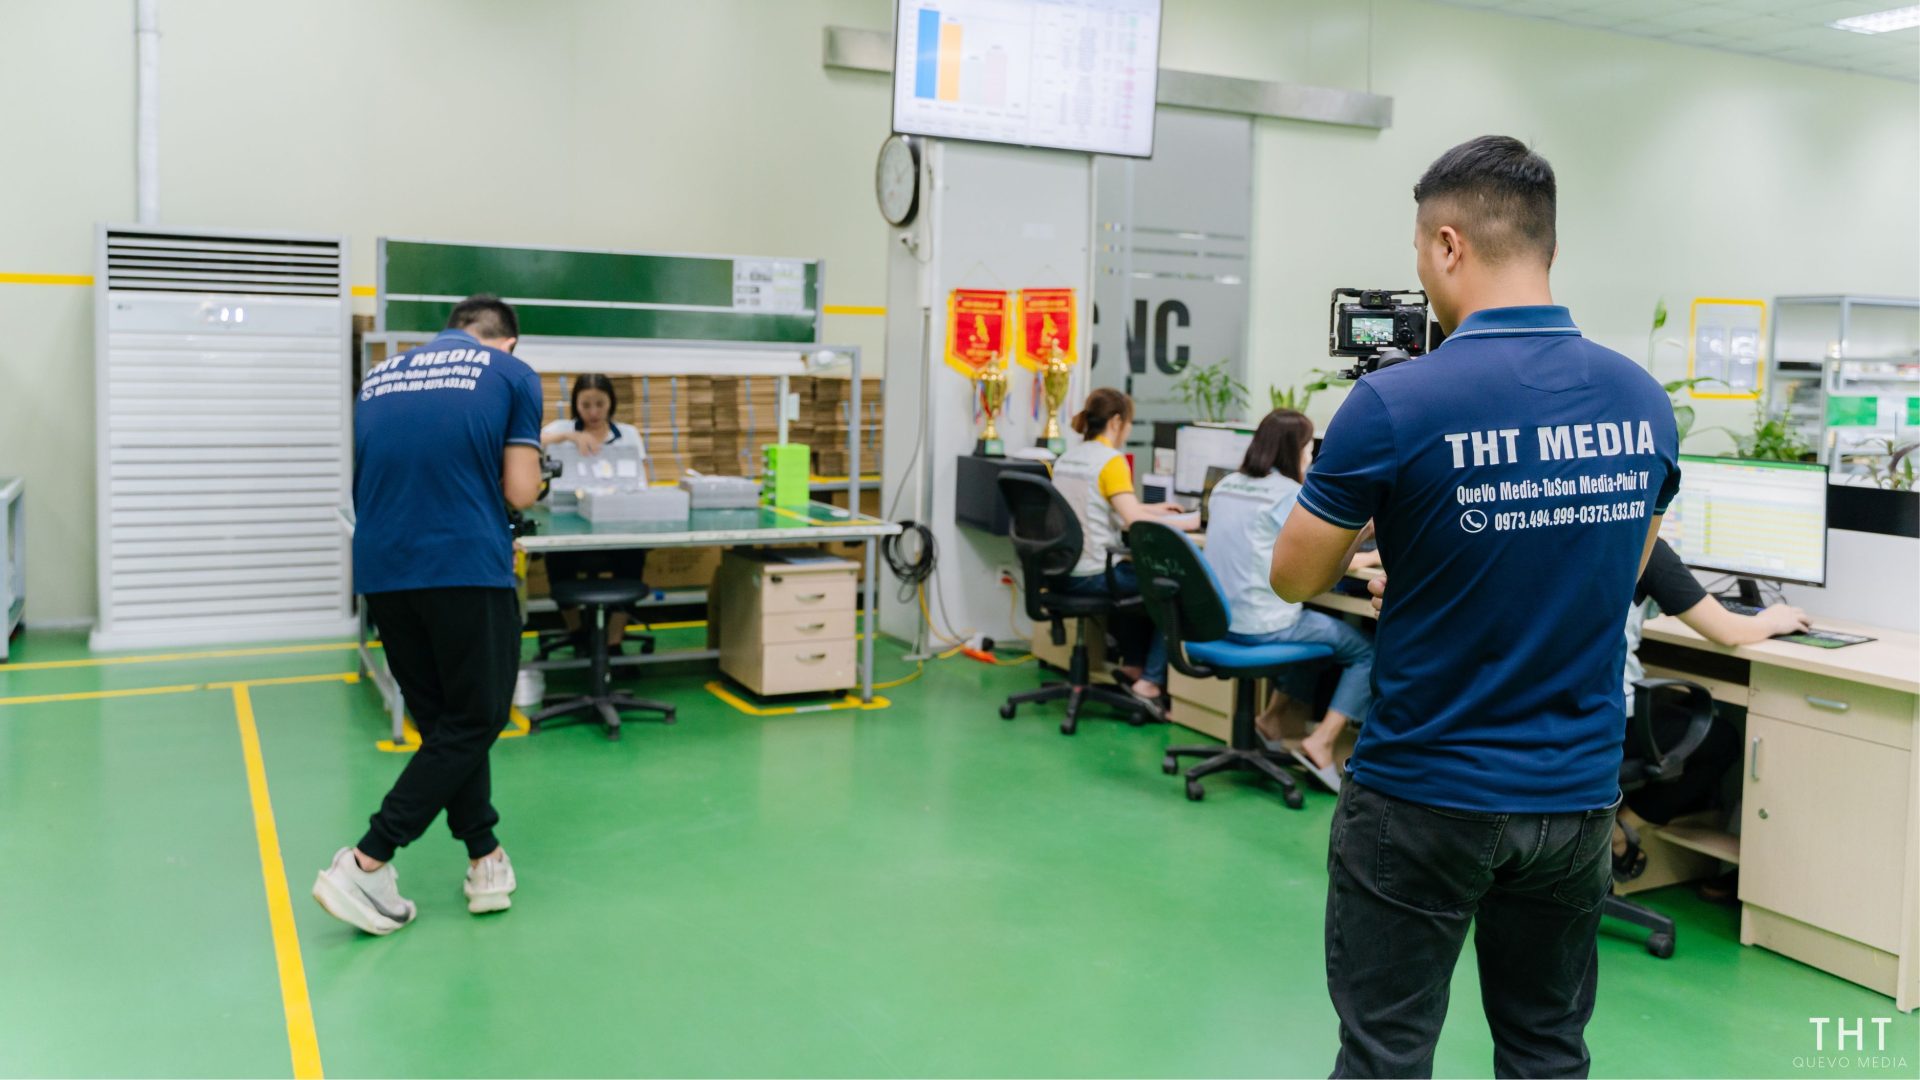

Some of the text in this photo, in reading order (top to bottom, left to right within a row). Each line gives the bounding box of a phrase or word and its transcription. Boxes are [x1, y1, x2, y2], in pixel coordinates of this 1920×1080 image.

[410, 348, 491, 367] MEDIA
[1445, 420, 1656, 469] THT MEDIA
[1456, 483, 1496, 506] QueVo
[1500, 477, 1577, 501] Media-TuSon
[1639, 471, 1650, 490] TV
[1494, 500, 1646, 531] 0973.494.999-0375.433.678
